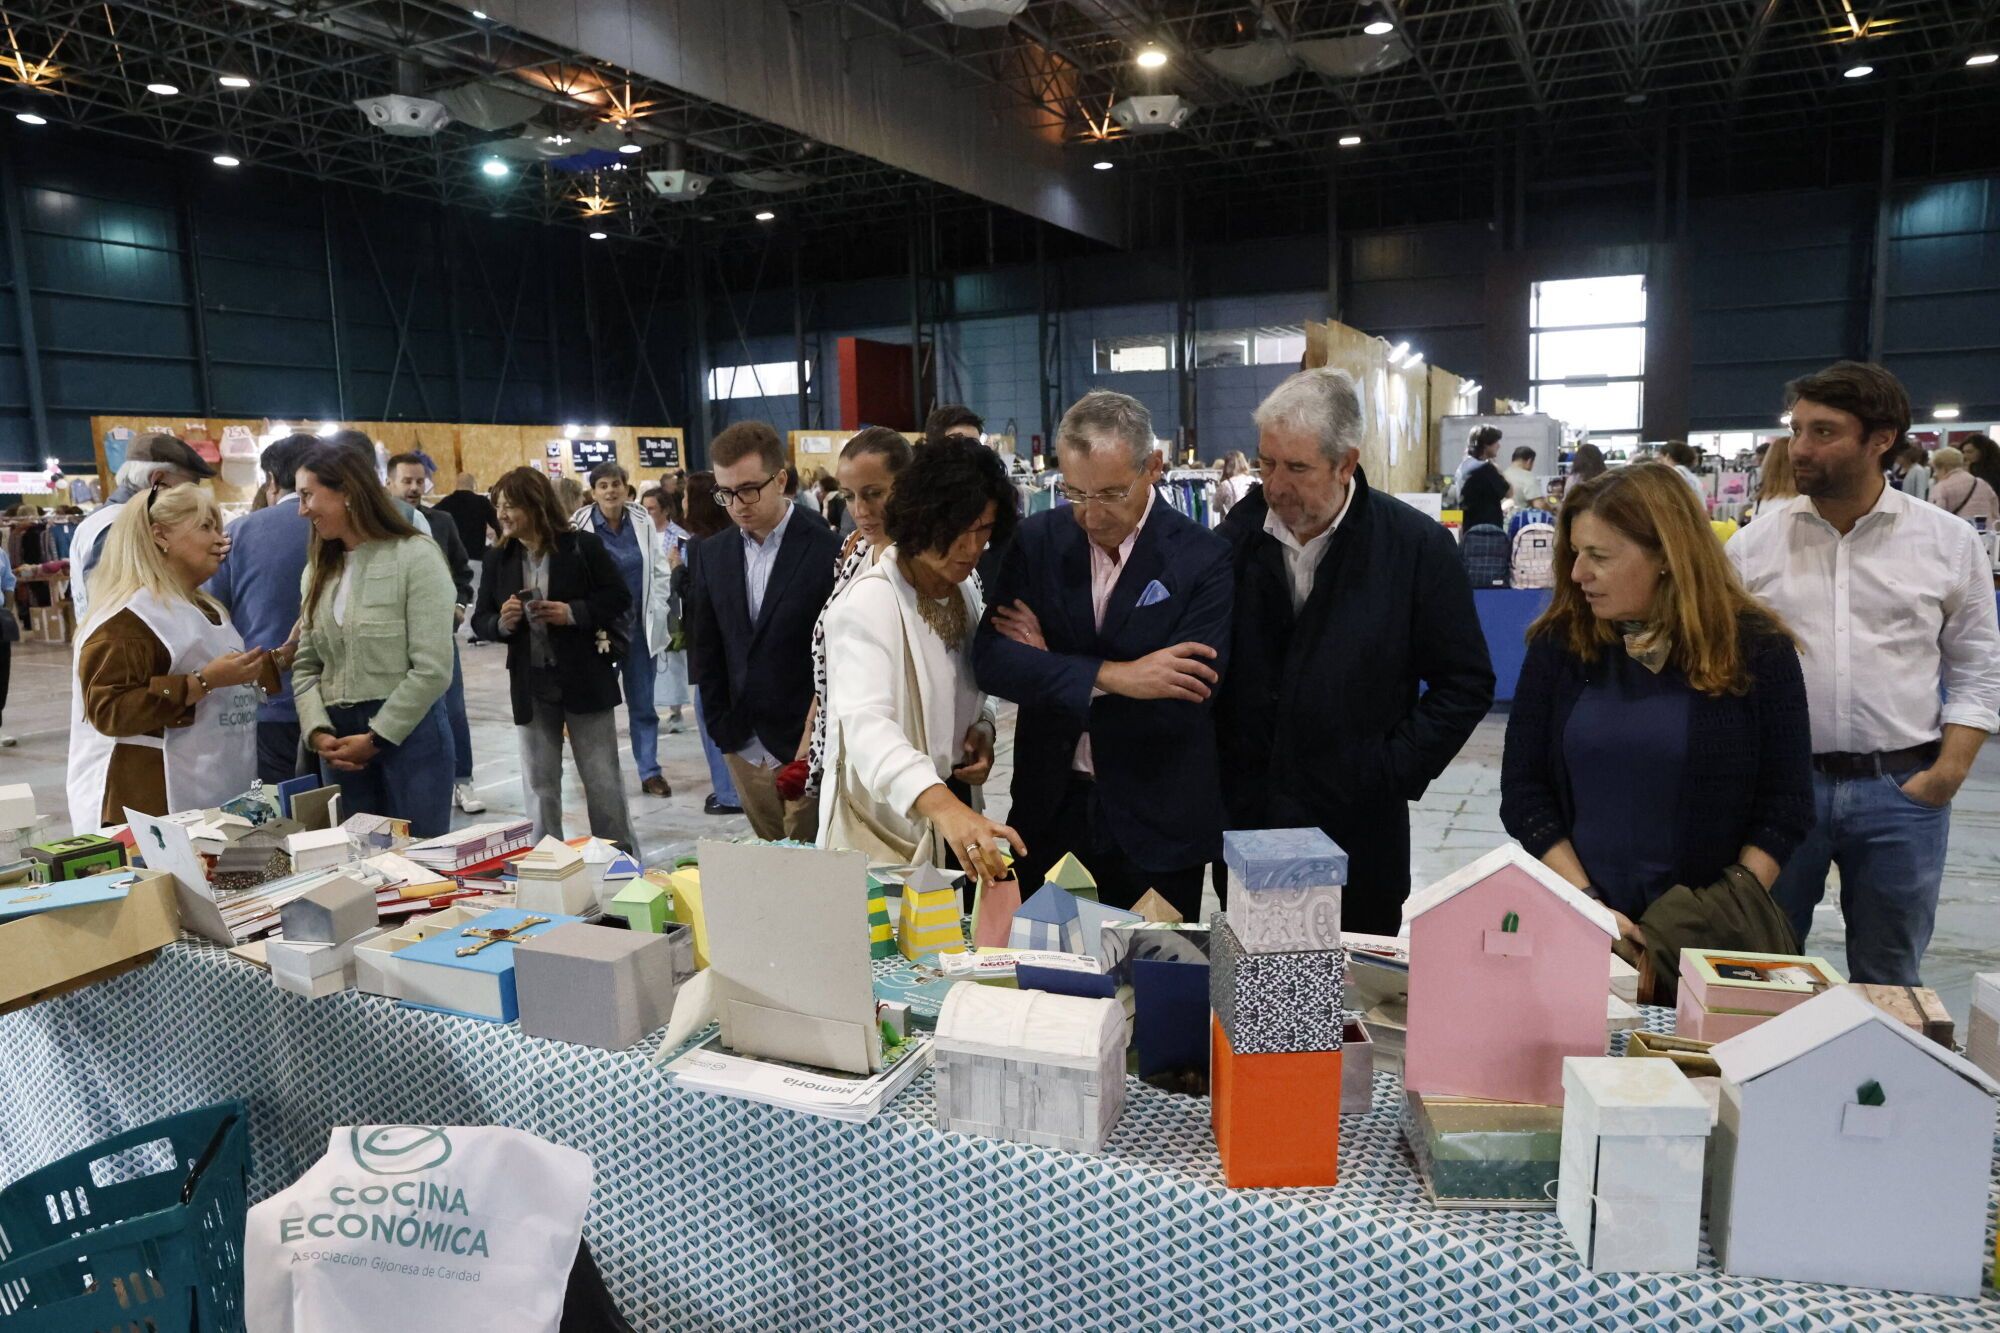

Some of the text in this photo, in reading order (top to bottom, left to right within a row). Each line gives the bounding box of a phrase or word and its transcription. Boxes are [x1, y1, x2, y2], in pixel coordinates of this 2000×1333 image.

[783, 1077, 857, 1094] Memoria
[329, 1181, 469, 1216] COCINA
[280, 1210, 489, 1258] ECONÓMICA
[371, 1256, 419, 1276] Gijonesa
[422, 1265, 435, 1277] de
[438, 1266, 481, 1282] Caridad
